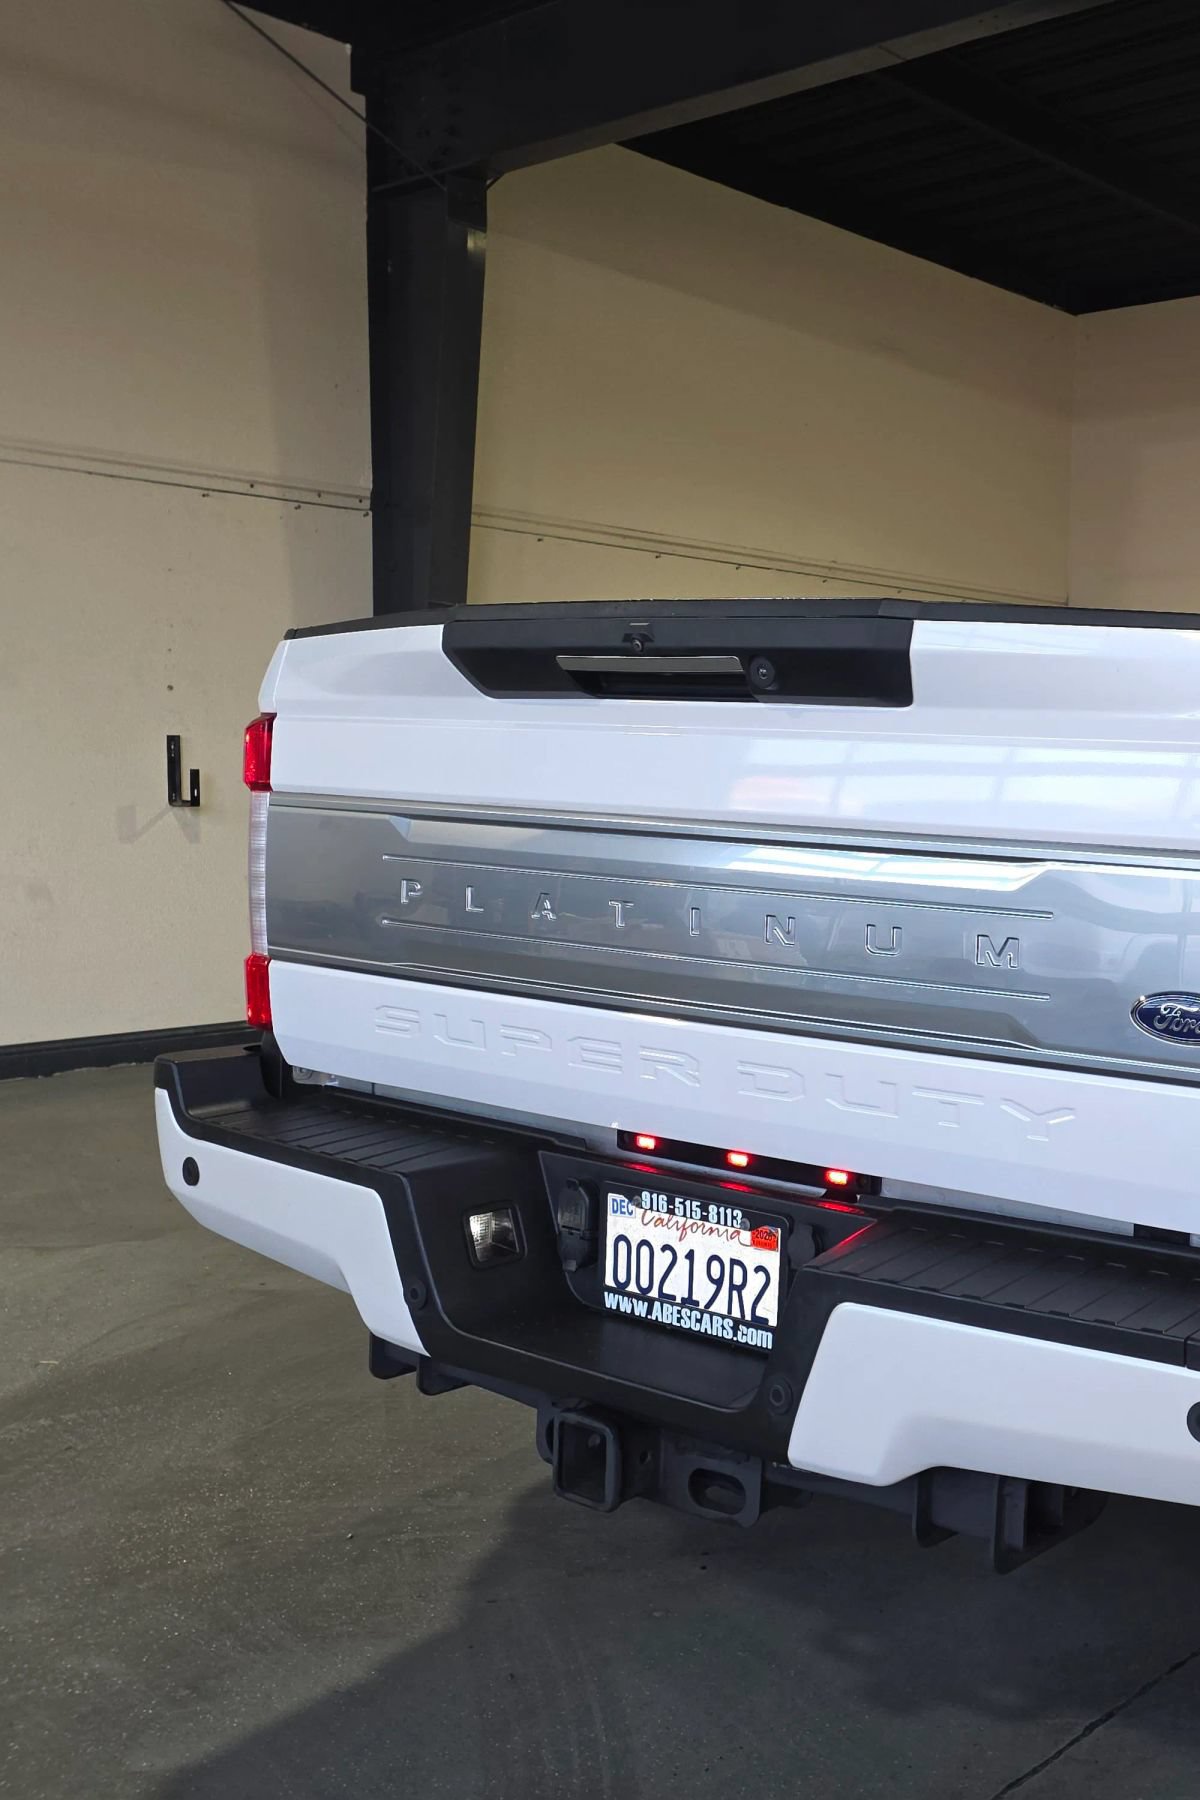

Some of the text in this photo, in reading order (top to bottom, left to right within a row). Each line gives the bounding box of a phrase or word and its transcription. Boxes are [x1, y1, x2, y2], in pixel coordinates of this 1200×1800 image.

[400, 877, 1020, 970] PLATINUM
[375, 1004, 1076, 1142] SUPER DUTY
[611, 1197, 635, 1216] DEC
[641, 1190, 743, 1229] 916-515-8113
[641, 1209, 752, 1247] California
[613, 1233, 771, 1325] 00219R2
